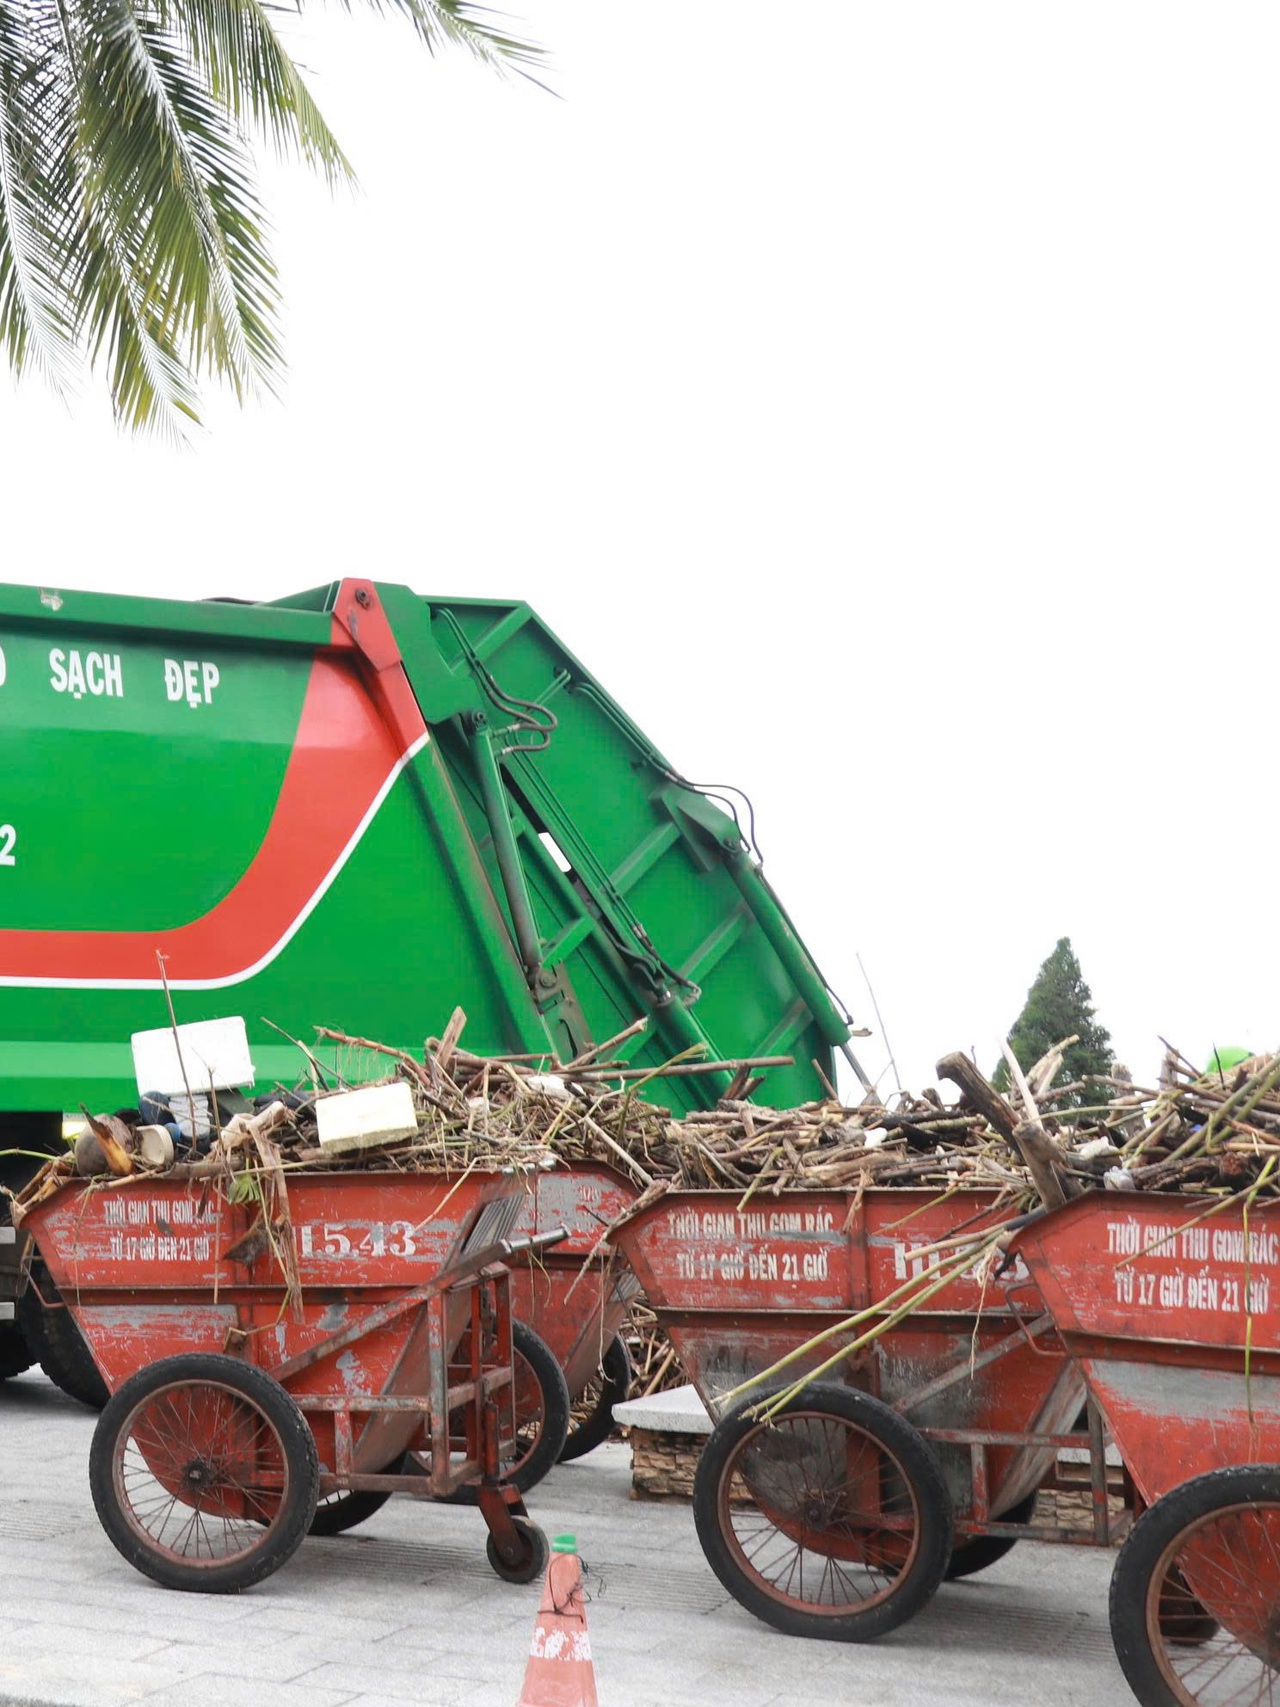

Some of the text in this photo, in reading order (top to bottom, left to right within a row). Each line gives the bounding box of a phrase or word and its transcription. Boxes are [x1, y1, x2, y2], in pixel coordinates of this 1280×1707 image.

[49, 648, 124, 699] SẠCH
[164, 658, 220, 709] ĐẸP
[128, 1200, 150, 1224] GIAN
[151, 1200, 170, 1224] THU
[172, 1200, 193, 1224] GOM
[703, 1212, 735, 1240] GIAN
[738, 1213, 766, 1240] THU
[179, 1237, 192, 1262] 21
[1107, 1214, 1279, 1265] THỜI GIAN THU GOM RÁC
[782, 1253, 799, 1281] 21
[803, 1247, 828, 1281] GIỜ
[1114, 1264, 1270, 1314] TỪ 17 GIỜ ĐẾN 21 GIỜ
